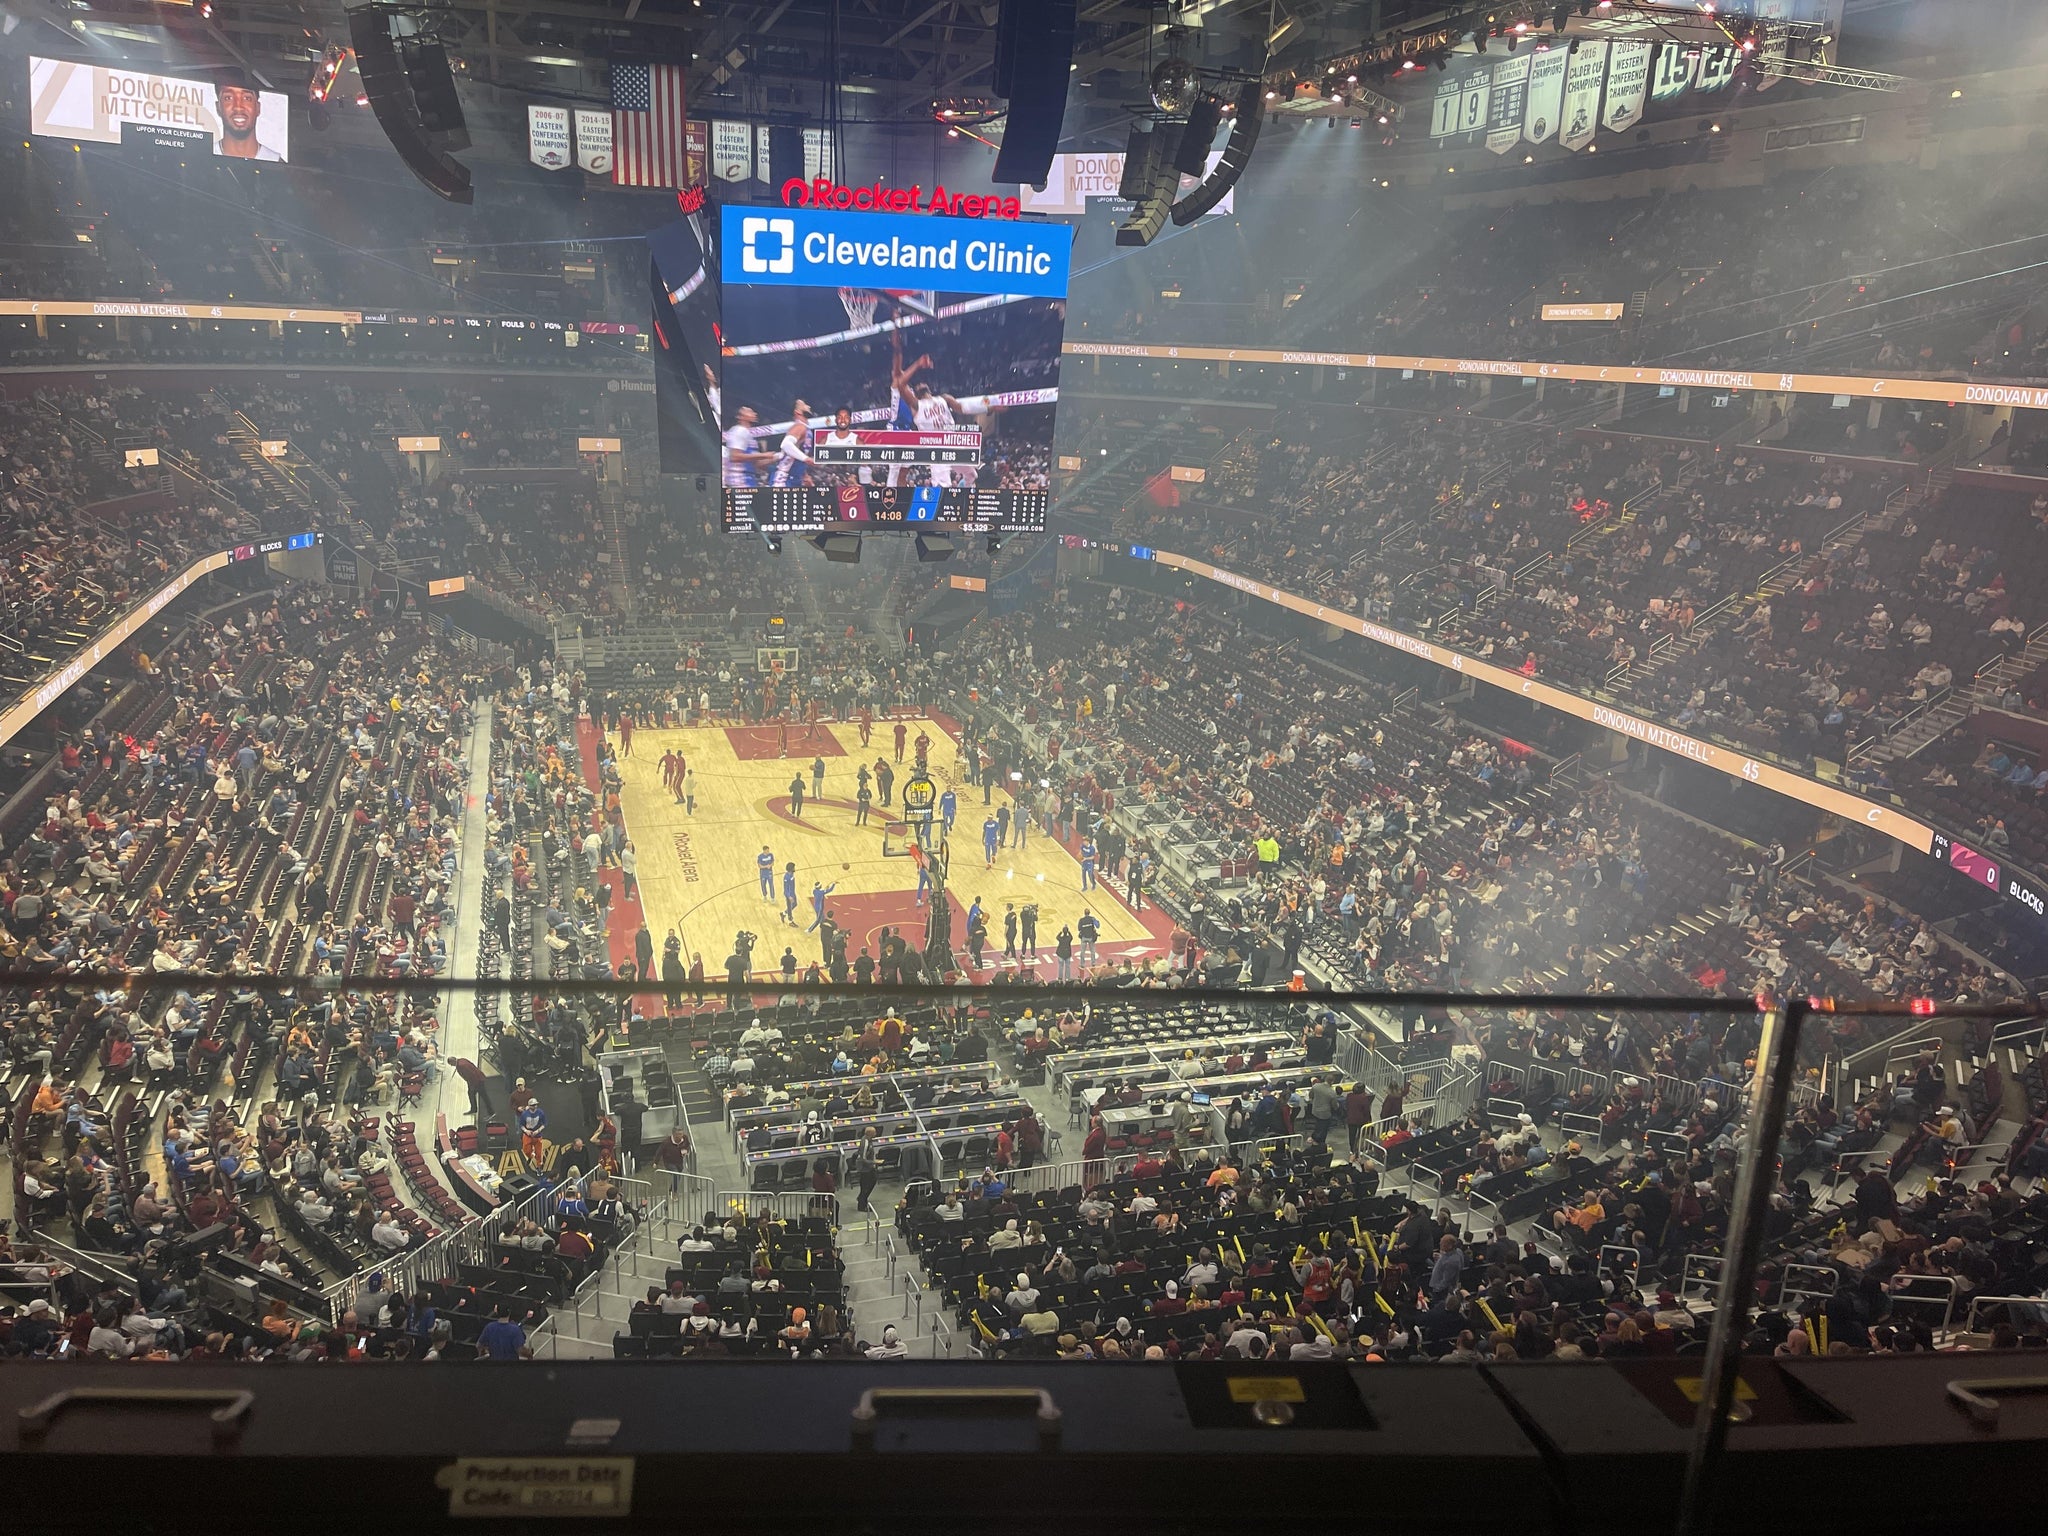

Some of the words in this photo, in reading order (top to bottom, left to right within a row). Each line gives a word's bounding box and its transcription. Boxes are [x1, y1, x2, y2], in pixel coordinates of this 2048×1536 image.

[1616, 56, 1644, 70] WESTERN
[108, 76, 204, 106] DONOVAN
[1568, 76, 1601, 93] CHAMPIONS
[100, 96, 205, 126] MITCHELL
[535, 110, 564, 120] 2006-07
[1442, 99, 1448, 132] 1
[1468, 92, 1478, 126] 9
[536, 122, 563, 130] EASTERN
[581, 116, 610, 124] 2014-15
[156, 128, 172, 136] YOUR
[173, 130, 204, 140] CLEVELAND
[532, 130, 569, 140] CONFERENCE
[583, 126, 608, 134] EASTERN
[718, 124, 745, 134] 2016-17
[154, 138, 184, 148] CAVALIERS
[534, 139, 568, 149] CHAMPIONS
[720, 134, 744, 144] EASTERN
[714, 144, 750, 153] CONFERENCE
[716, 152, 748, 162] CHAMPIONS
[812, 178, 921, 213] Rocket
[930, 194, 1020, 219] Arena
[804, 232, 956, 270] Cleveland
[965, 240, 1051, 276] Clinic
[94, 304, 136, 315] DONOVAN
[140, 305, 188, 316] MITCHELL
[210, 308, 222, 317] 45
[486, 320, 491, 328] 7
[502, 320, 524, 328] FOULS
[530, 321, 536, 330] 0
[544, 322, 562, 330] FG%
[568, 322, 574, 331] 0
[619, 324, 625, 334] 0
[1072, 344, 1109, 354] DONOVAN
[1110, 345, 1149, 356] MITCHELL
[1168, 348, 1178, 356] 45
[1282, 353, 1314, 364] DONOVAN
[1316, 354, 1350, 365] MITCHELL
[1366, 355, 1376, 366] 45
[1460, 361, 1488, 372] DONOVAN
[1490, 362, 1522, 374] MITCHELL
[1539, 365, 1548, 376] 45
[1660, 372, 1702, 384] DONOVAN
[1704, 373, 1754, 387] MITCHELL
[1780, 375, 1792, 390] 45
[1000, 391, 1039, 406] TREES
[1966, 386, 2030, 405] DONOVAN
[920, 436, 942, 445] DONOVAN
[943, 436, 978, 446] MITCHELL
[818, 450, 830, 459] PTS
[846, 450, 854, 460] 17
[860, 451, 872, 460] FGS
[880, 450, 894, 460] 4/11
[901, 451, 914, 460] ASTS
[942, 452, 956, 460] REBS
[971, 452, 976, 462] 3
[868, 490, 880, 498] 1Q
[848, 506, 858, 519] 0
[875, 512, 902, 520] 14:08
[918, 508, 926, 519] 0
[962, 524, 988, 532] $5,329
[260, 542, 282, 552] BLOCKS
[1082, 538, 1088, 548] 0
[1212, 568, 1236, 588] DONOVAN
[1236, 576, 1260, 595] MITCHELL
[1272, 590, 1280, 602] 45
[1362, 622, 1395, 645] DONOVAN
[1395, 634, 1432, 659] MITCHELL
[1452, 656, 1462, 669] 45
[1593, 706, 1646, 738] DONOVAN
[1647, 724, 1710, 762] MITCHELL
[1742, 760, 1759, 780] 45
[1935, 834, 1948, 848] FG%
[1936, 848, 1942, 858] 0
[1986, 868, 1995, 884] 0
[2010, 880, 2044, 916] BLOCKS
[466, 1466, 570, 1482] Production
[578, 1466, 620, 1482] Date
